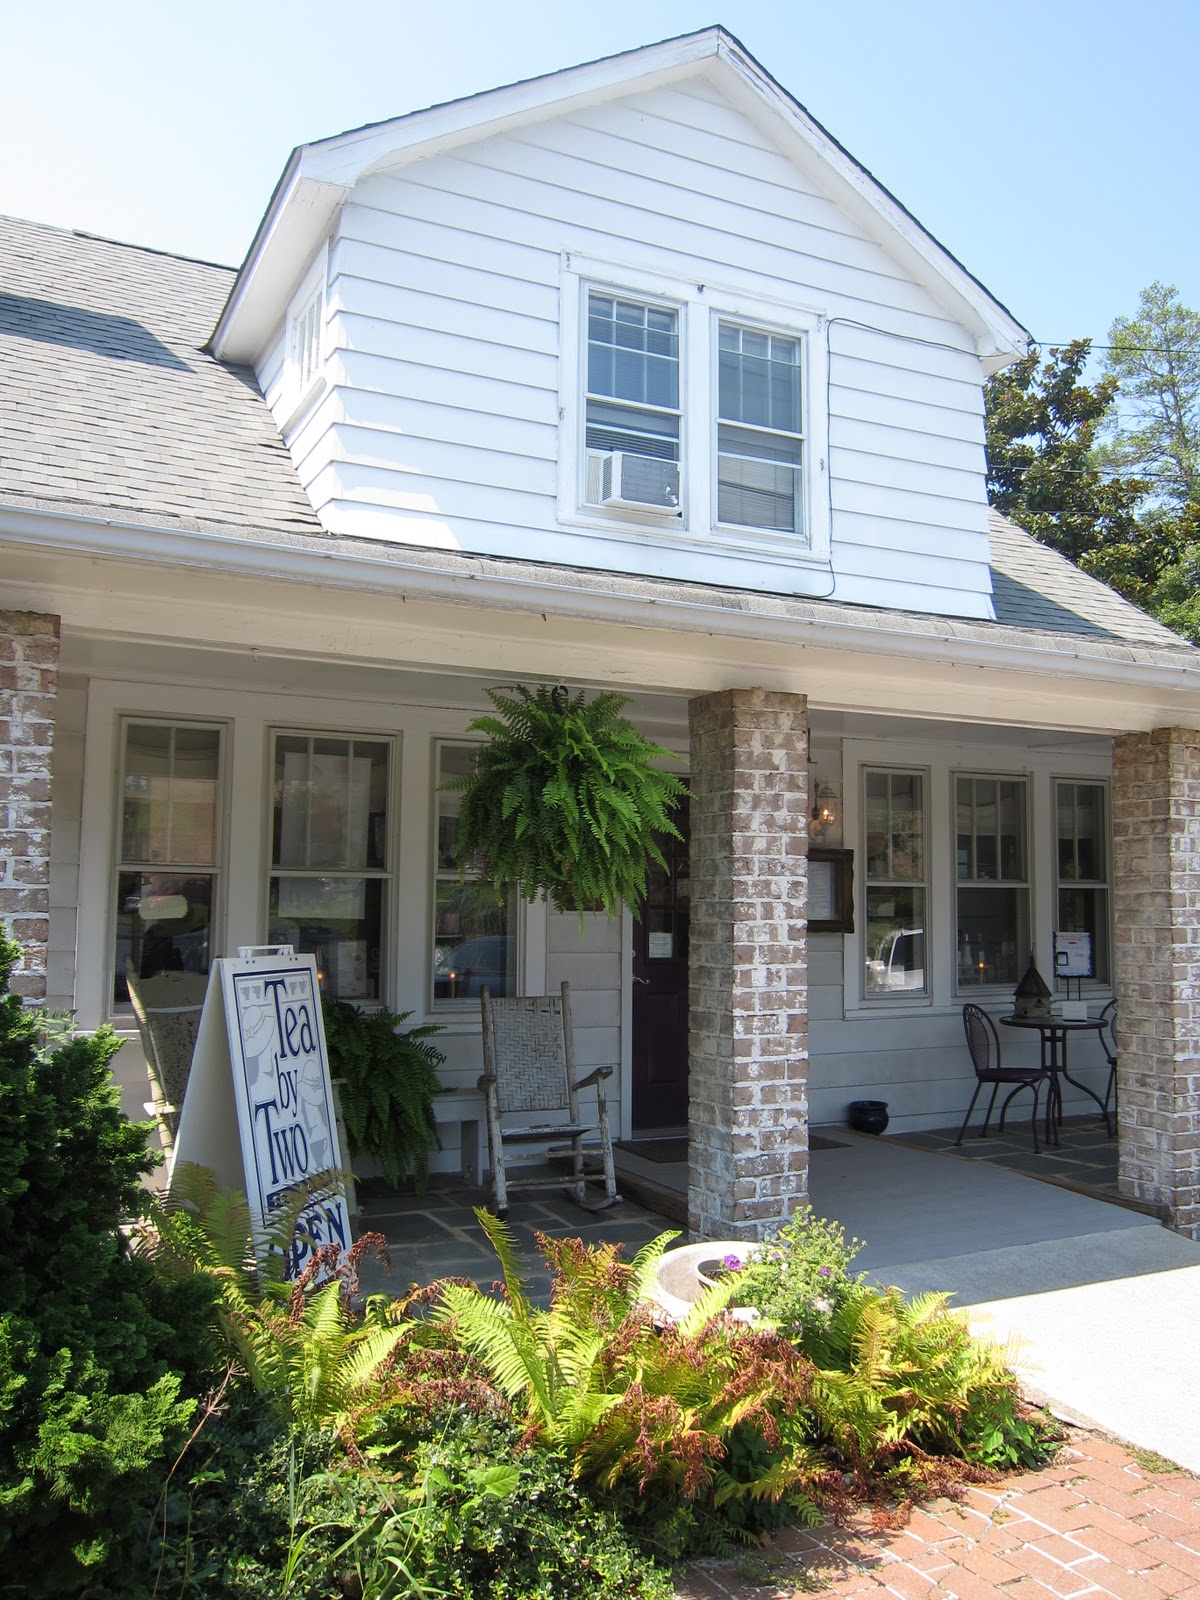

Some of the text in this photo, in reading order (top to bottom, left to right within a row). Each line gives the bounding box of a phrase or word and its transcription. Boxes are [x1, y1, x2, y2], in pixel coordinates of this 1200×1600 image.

[264, 978, 316, 1058] Tea
[274, 1052, 298, 1118] by
[255, 1098, 308, 1184] Two
[268, 1202, 346, 1281] PEN
